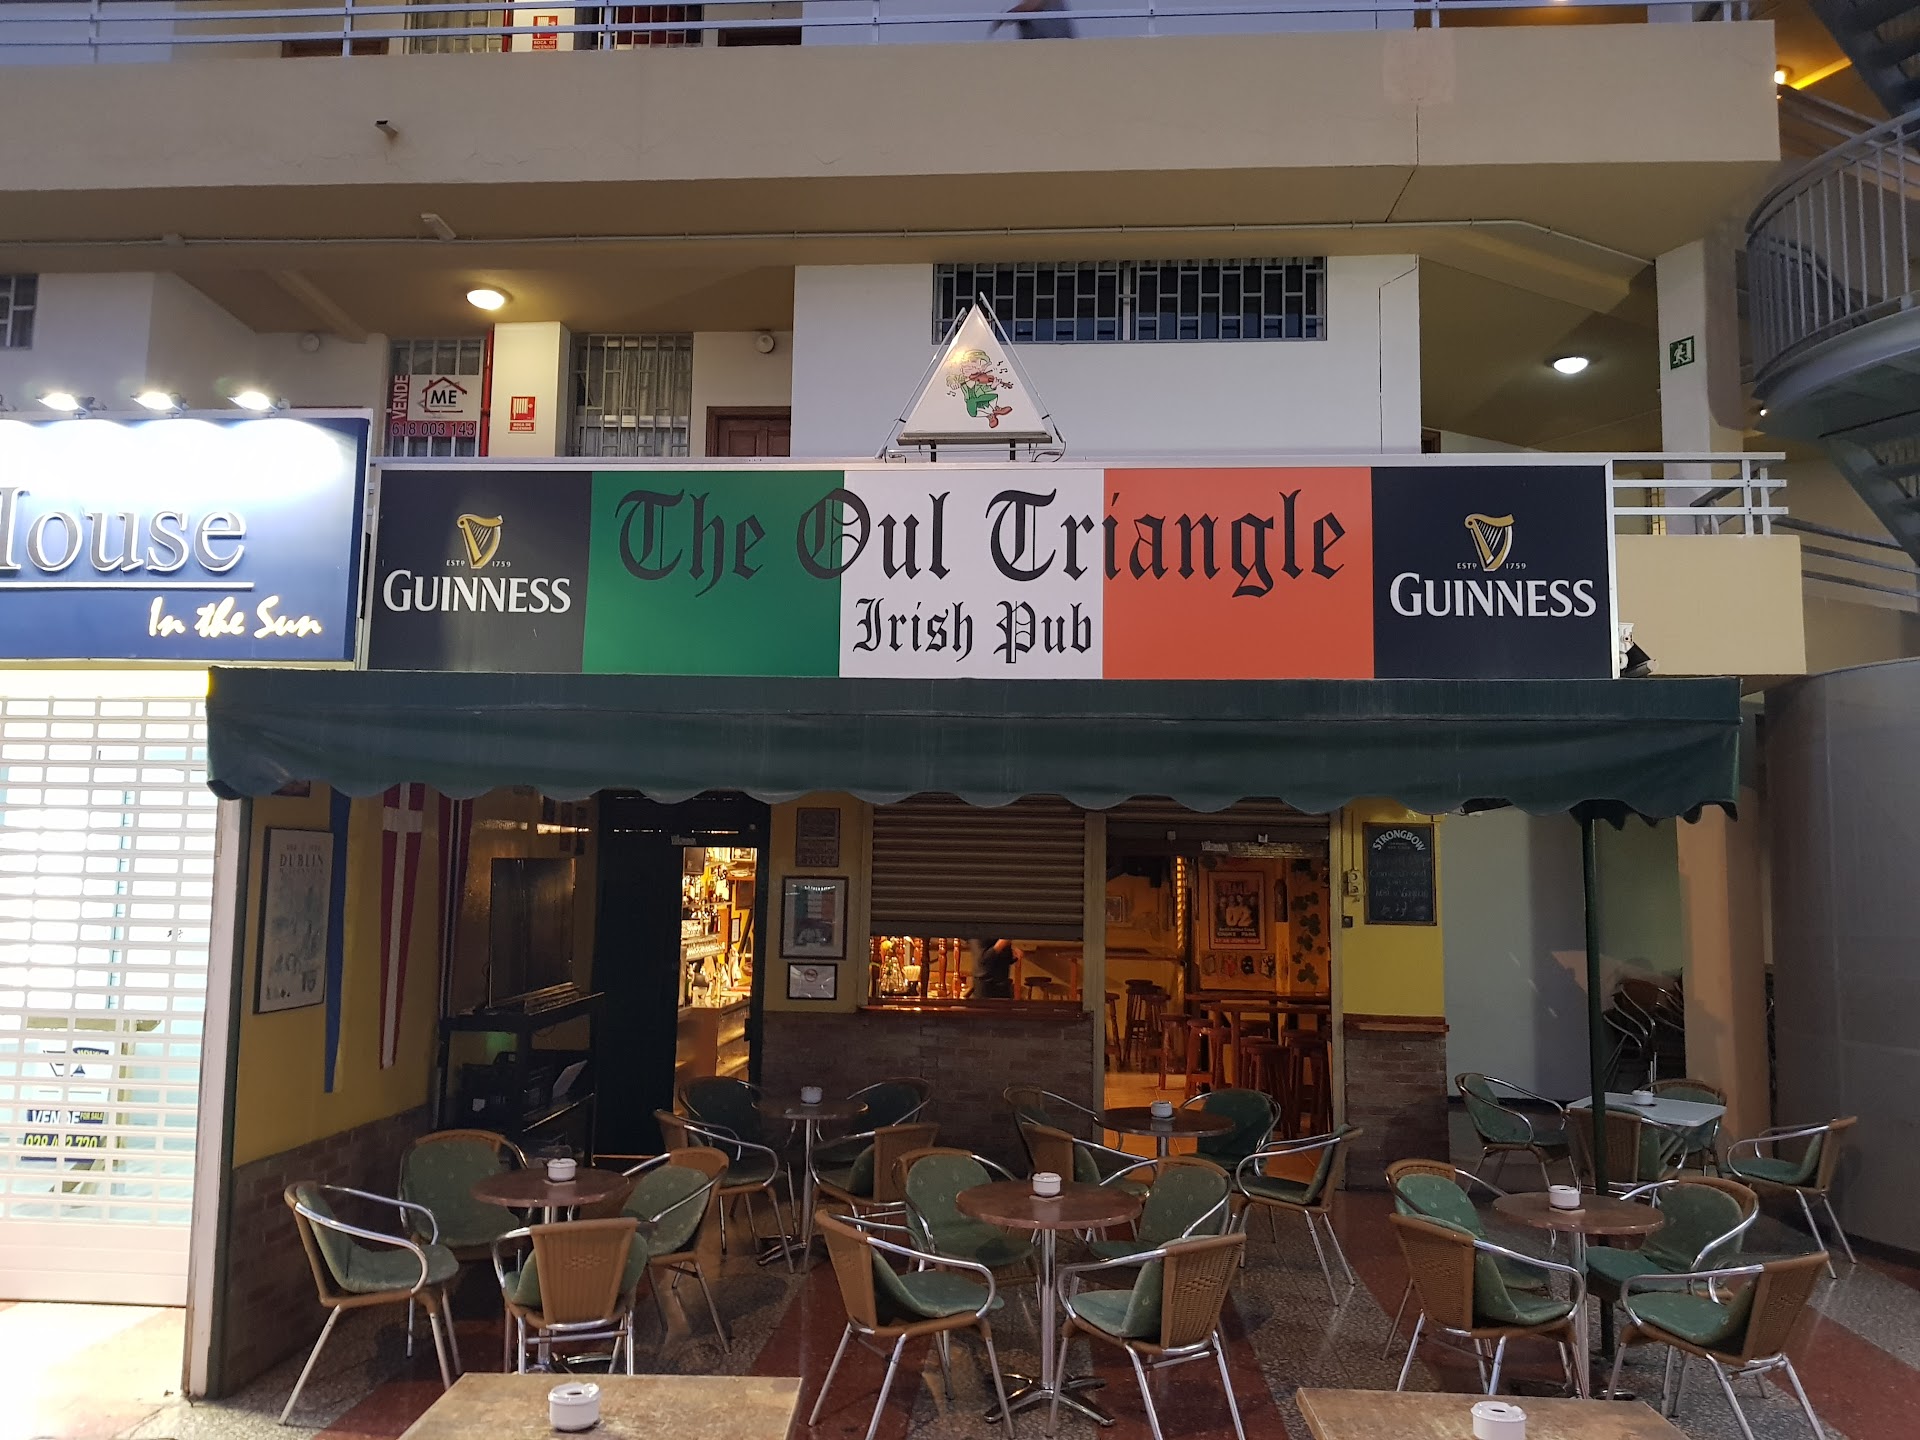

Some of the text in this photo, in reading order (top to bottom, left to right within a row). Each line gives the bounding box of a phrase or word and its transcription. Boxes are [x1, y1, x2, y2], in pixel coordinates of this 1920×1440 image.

[392, 374, 409, 420] VENDE
[430, 390, 457, 405] ME
[392, 421, 476, 437] 618 003 143
[614, 487, 1346, 599] The Oul Triangle
[492, 560, 512, 568] 1759
[1505, 562, 1527, 570] 1759
[382, 569, 571, 614] GUINNESS
[1389, 572, 1597, 618] GUINNESS
[148, 595, 322, 639] In the Sun
[853, 597, 1093, 664] Irish Pub
[1371, 829, 1426, 852] STRONGBOW
[280, 853, 324, 867] DUBLIN
